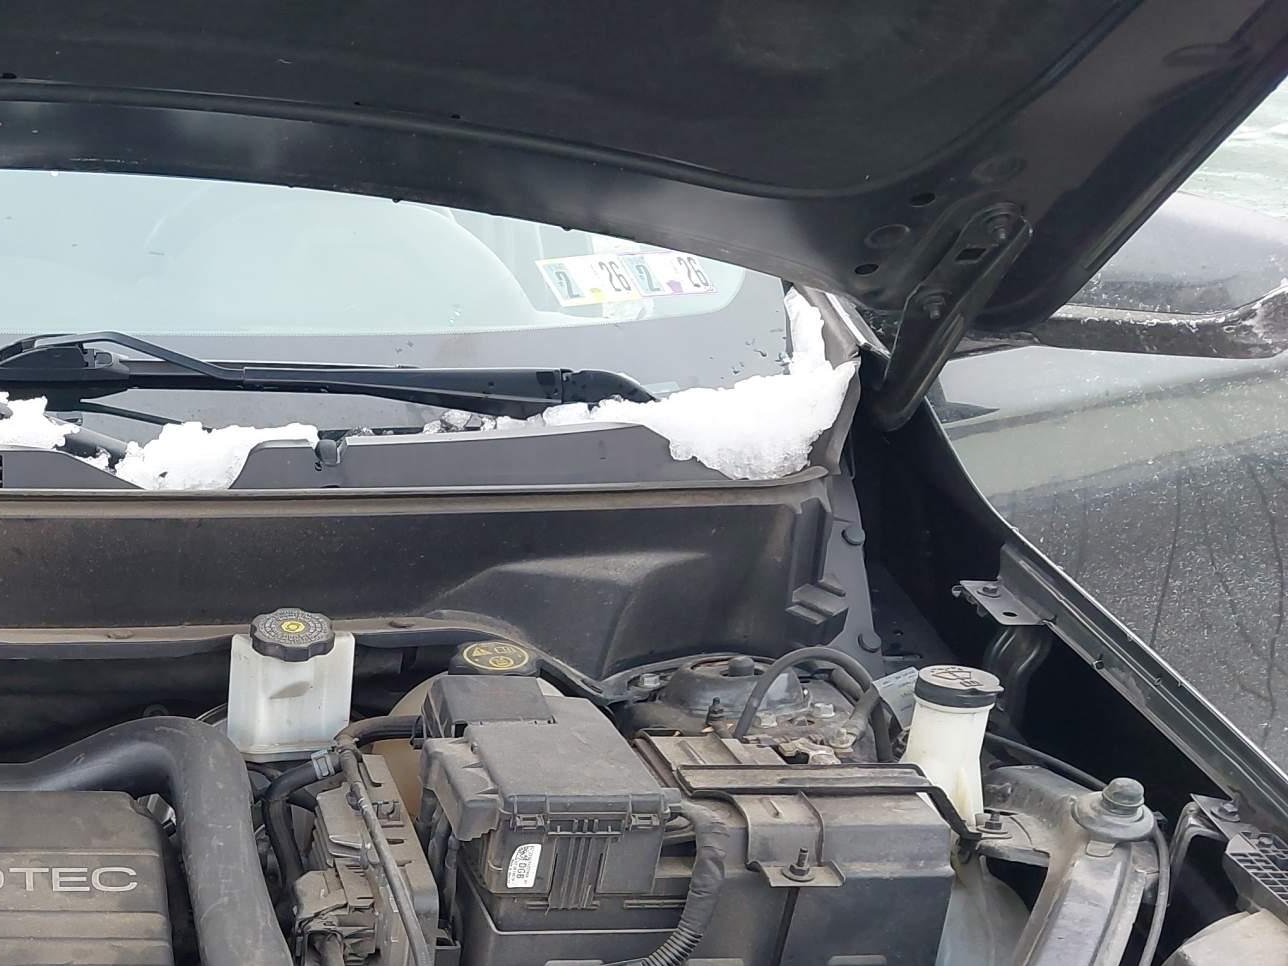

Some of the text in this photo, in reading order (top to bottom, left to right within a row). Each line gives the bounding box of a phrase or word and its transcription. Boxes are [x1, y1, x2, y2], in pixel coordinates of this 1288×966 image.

[555, 261, 631, 298] 2 26
[636, 256, 710, 292] 2 26
